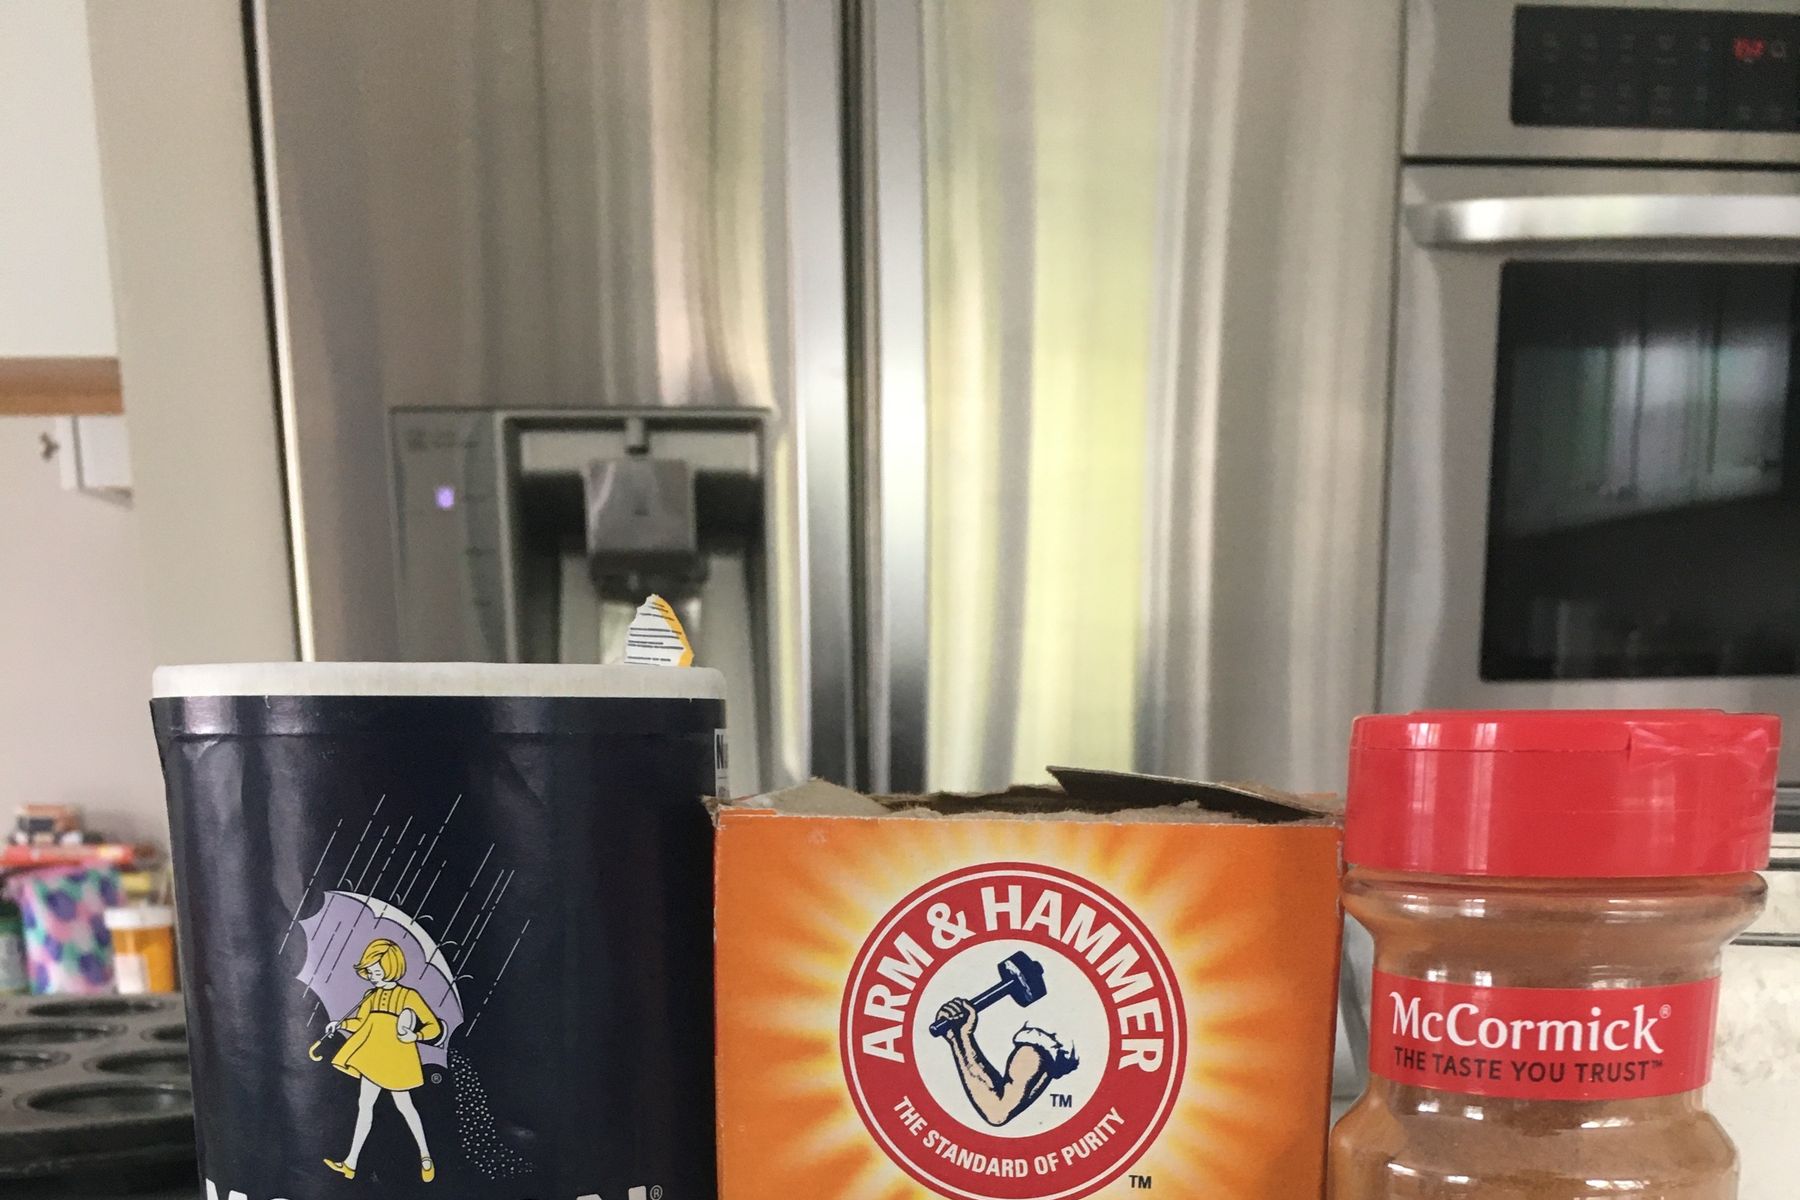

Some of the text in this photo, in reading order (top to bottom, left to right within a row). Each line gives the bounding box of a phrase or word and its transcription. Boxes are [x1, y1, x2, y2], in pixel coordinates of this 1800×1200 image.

[862, 884, 1165, 1073] ARM & HAMMER
[1394, 1046, 1426, 1072] THE
[1432, 1053, 1502, 1081] TASTE
[1511, 1060, 1566, 1083] YOU
[893, 1095, 1125, 1178] THE STANDARD OF PURITY
